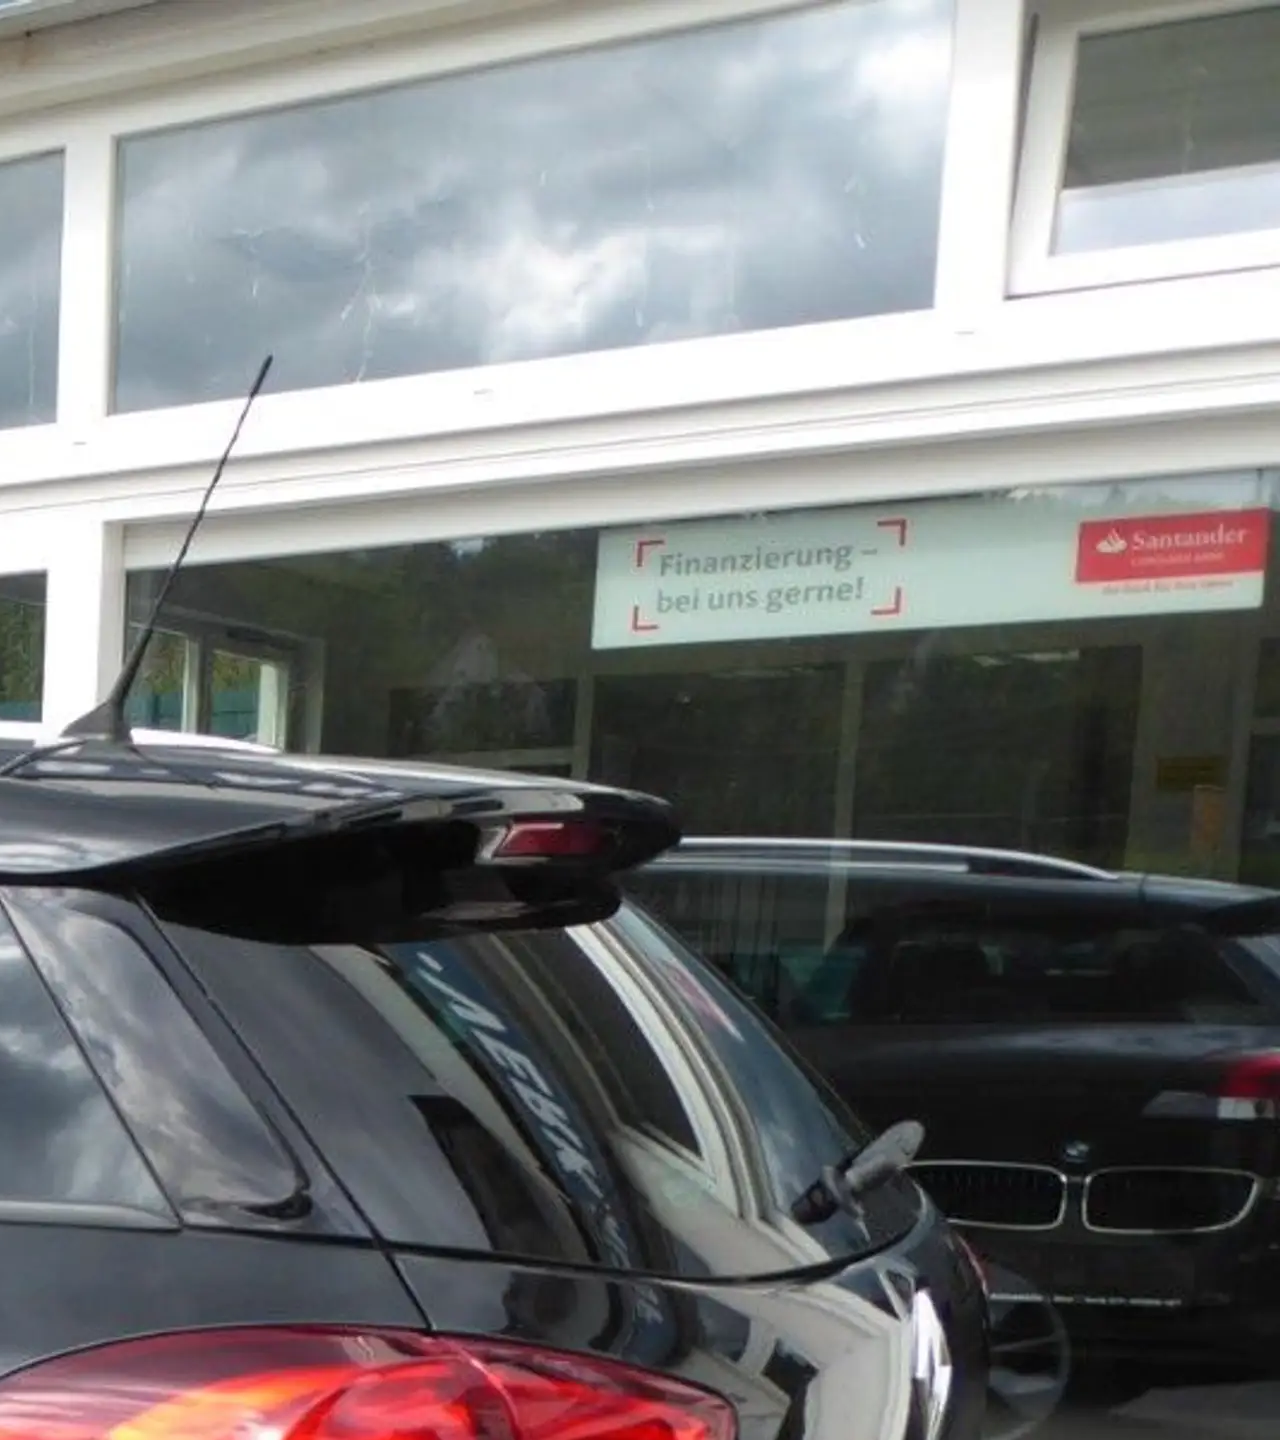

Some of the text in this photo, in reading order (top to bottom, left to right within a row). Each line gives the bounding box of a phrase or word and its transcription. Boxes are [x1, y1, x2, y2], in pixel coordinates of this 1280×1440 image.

[1131, 523, 1249, 549] Santander
[659, 545, 853, 577] Finanzierung
[657, 577, 865, 614] bei uns gerne!
